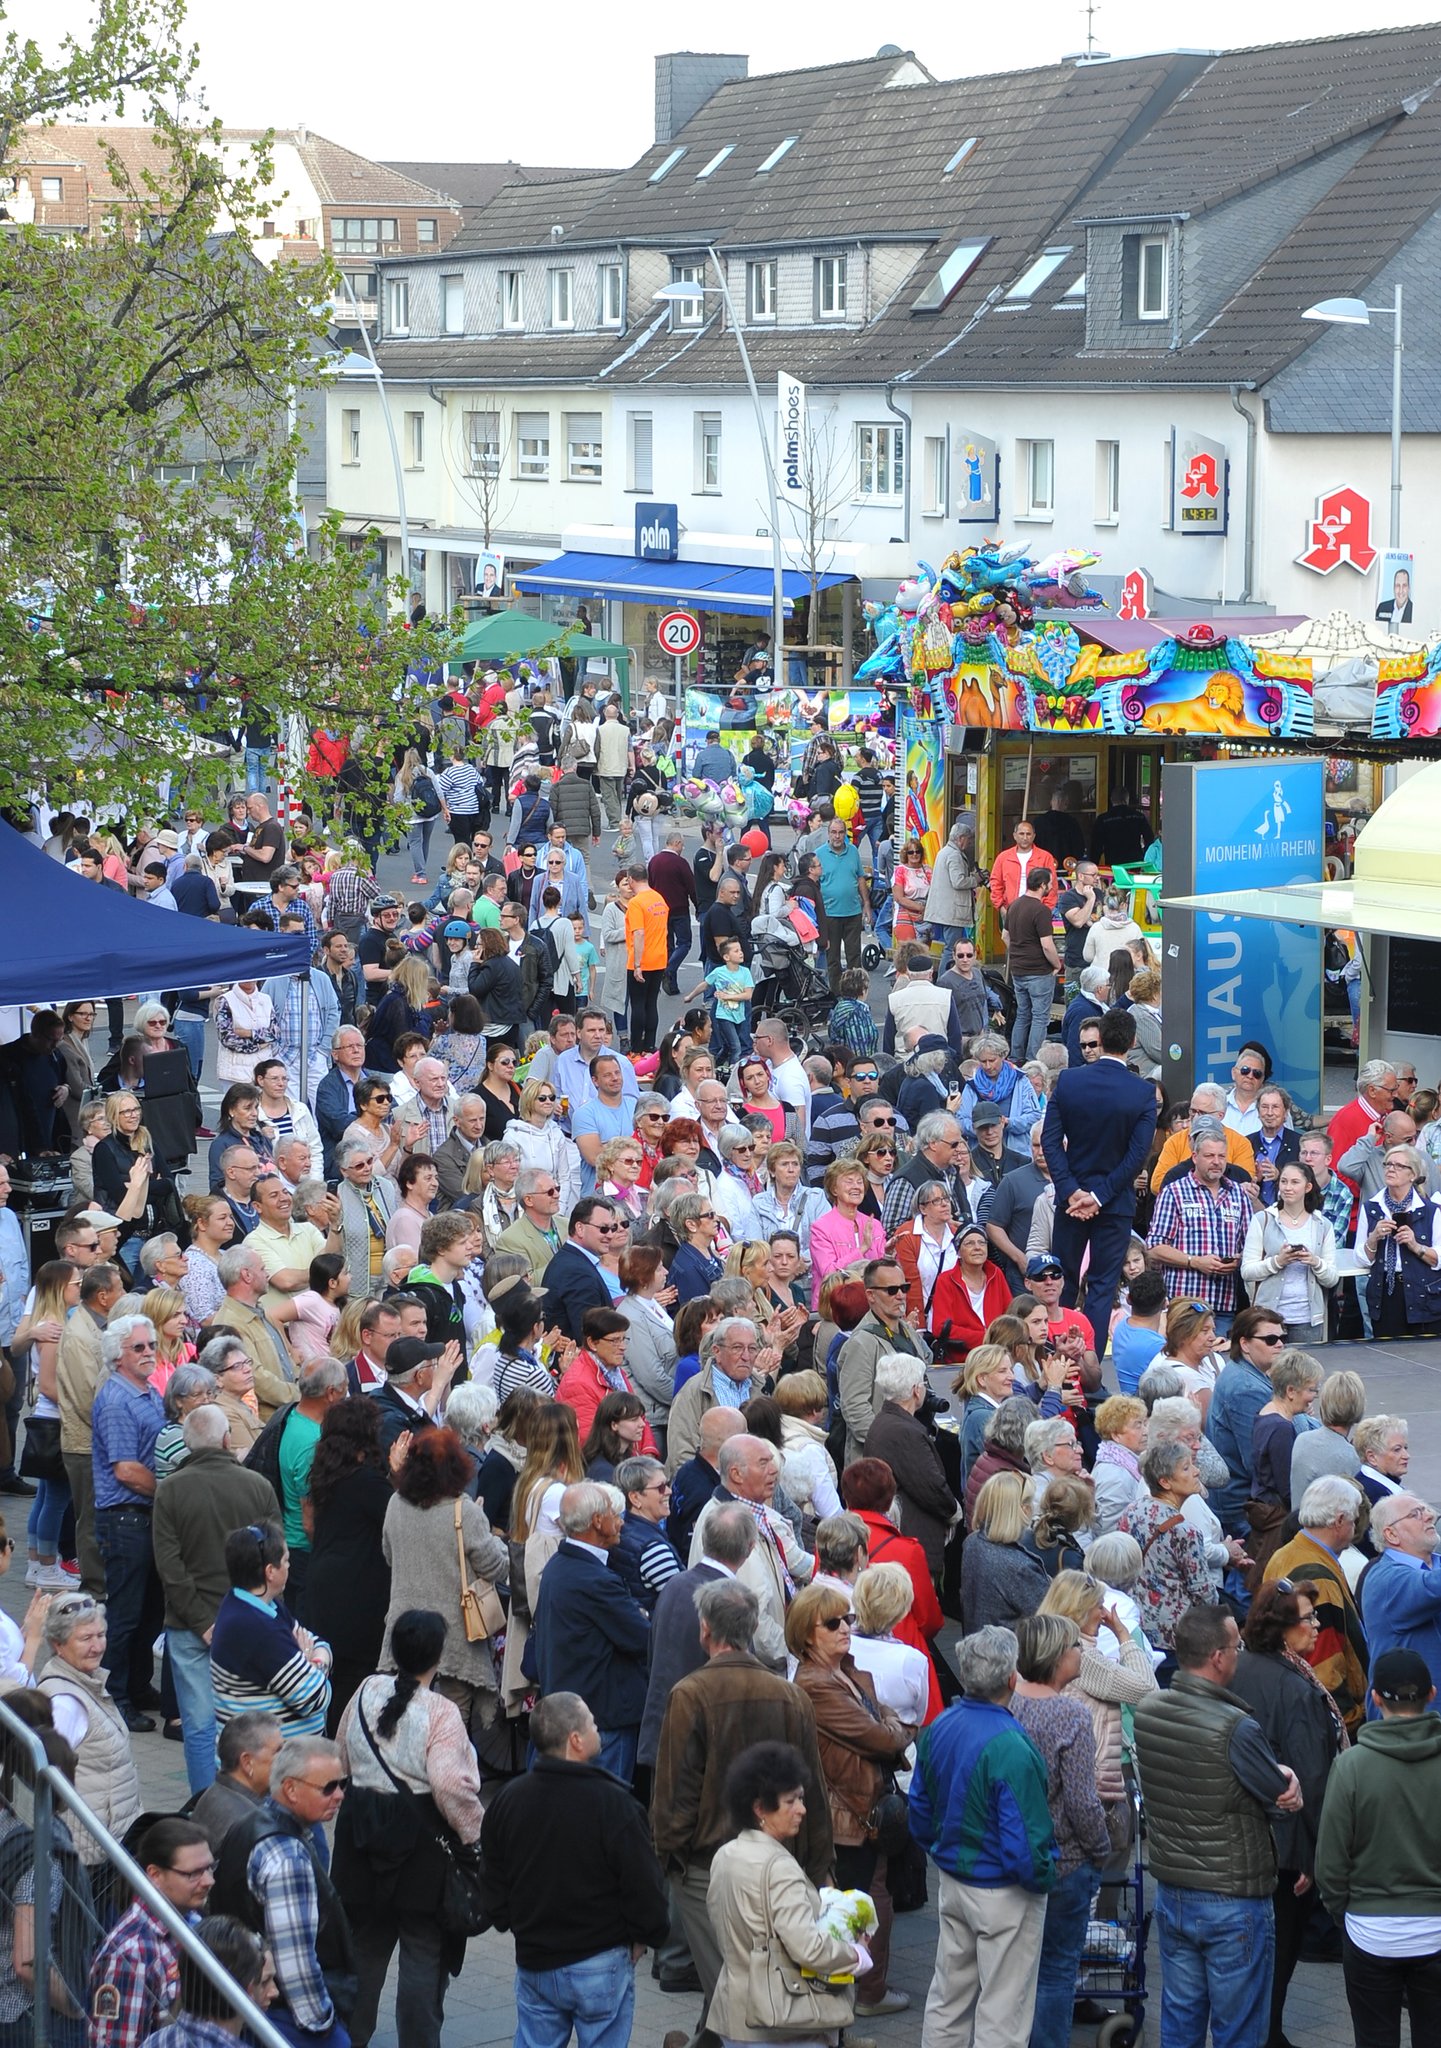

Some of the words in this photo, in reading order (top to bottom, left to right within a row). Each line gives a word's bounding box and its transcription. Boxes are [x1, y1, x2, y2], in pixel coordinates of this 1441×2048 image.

[783, 385, 802, 489] palmshoes
[640, 518, 670, 558] palm
[668, 625, 691, 643] 20
[1205, 844, 1262, 863] MONHEIM
[1263, 843, 1280, 858] AM
[1281, 840, 1316, 857] RHEIN
